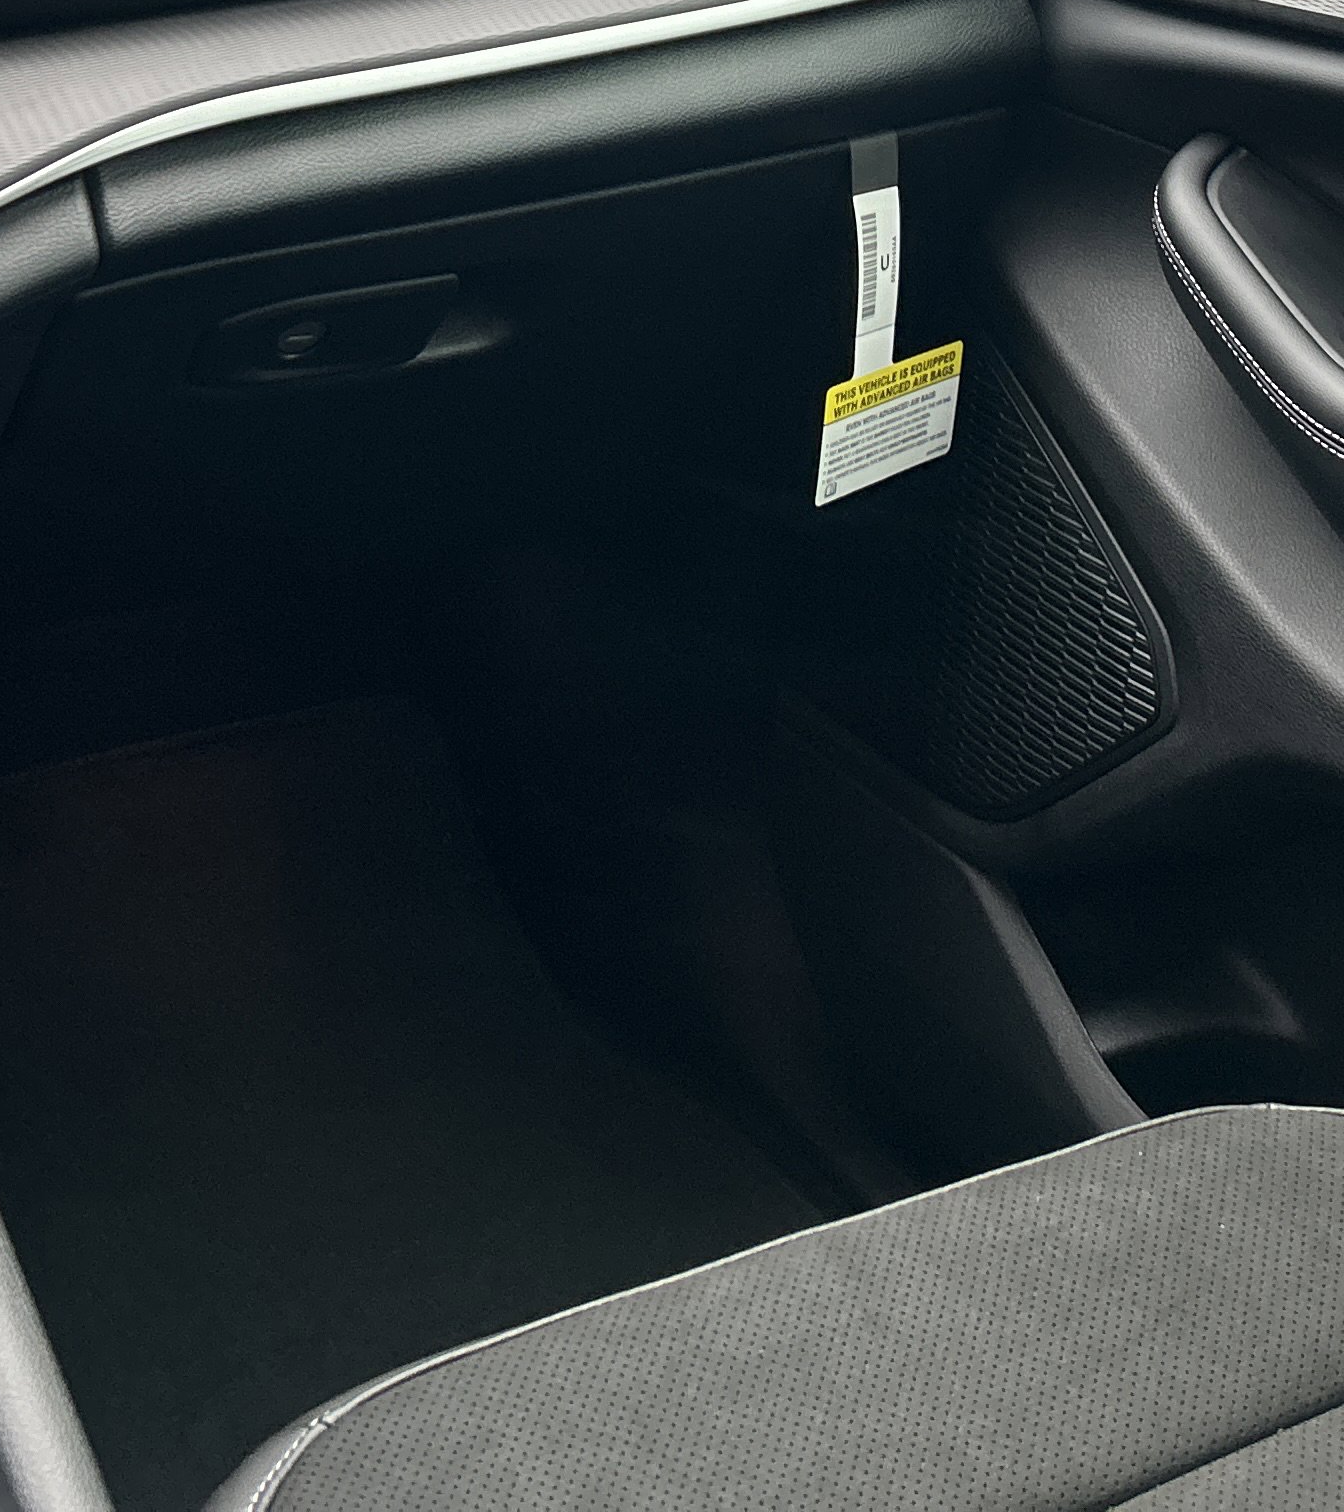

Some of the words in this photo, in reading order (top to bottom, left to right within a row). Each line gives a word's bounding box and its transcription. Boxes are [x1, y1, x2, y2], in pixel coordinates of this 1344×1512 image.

[833, 400, 859, 419] WITH
[859, 380, 911, 409] ADVANCED
[912, 373, 929, 389] AIR
[929, 364, 956, 383] BAGS
[834, 387, 858, 406] THIS
[857, 370, 898, 396] VEHICLE
[899, 367, 909, 380] IS
[910, 350, 957, 375] EQUIPPED
